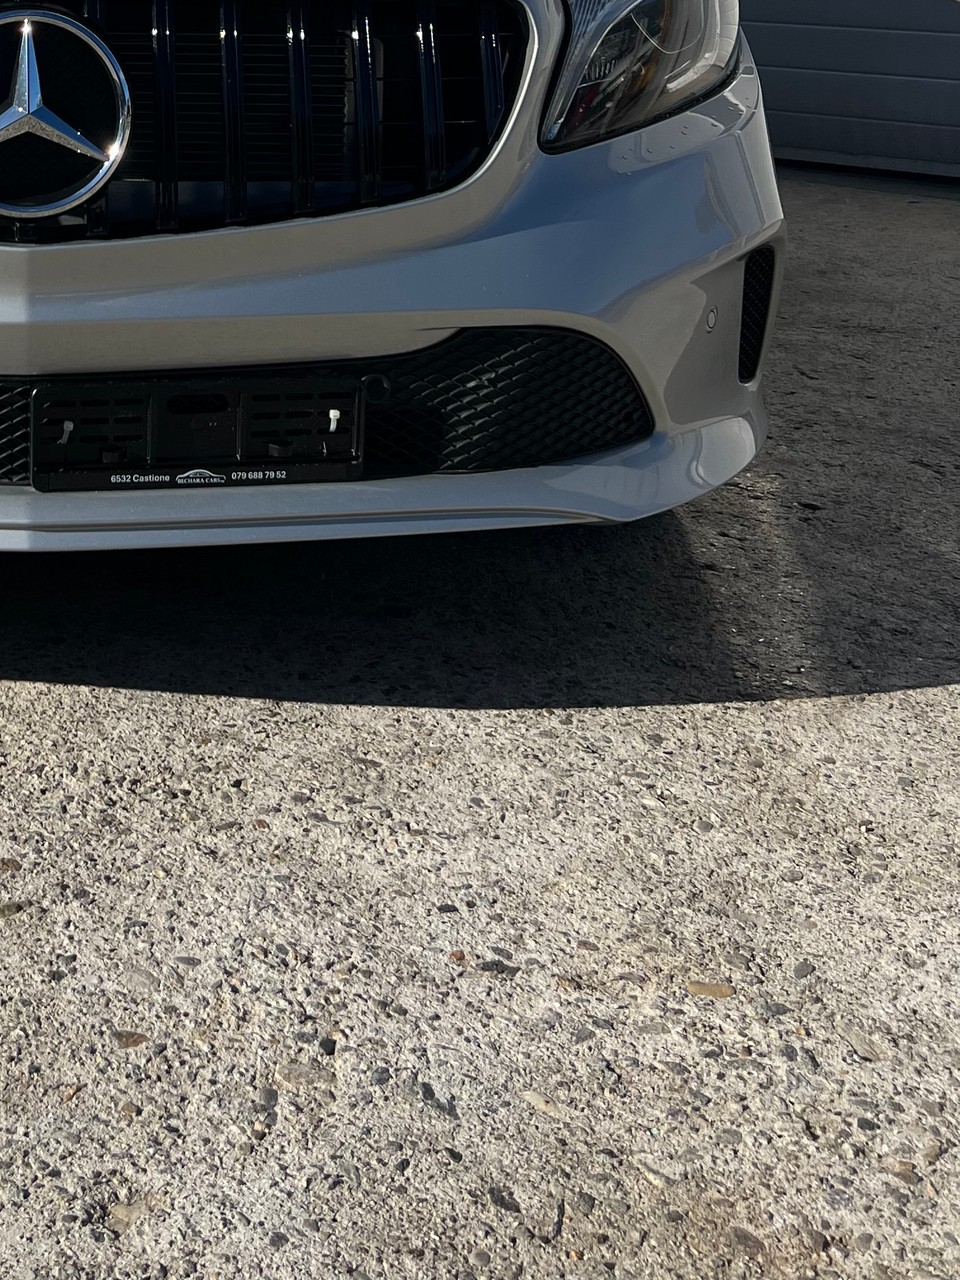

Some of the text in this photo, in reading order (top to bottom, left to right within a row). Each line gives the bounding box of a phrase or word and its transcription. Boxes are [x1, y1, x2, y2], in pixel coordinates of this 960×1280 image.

[110, 473, 170, 483] 6532 Castione
[231, 470, 287, 480] 079 688 79 52
